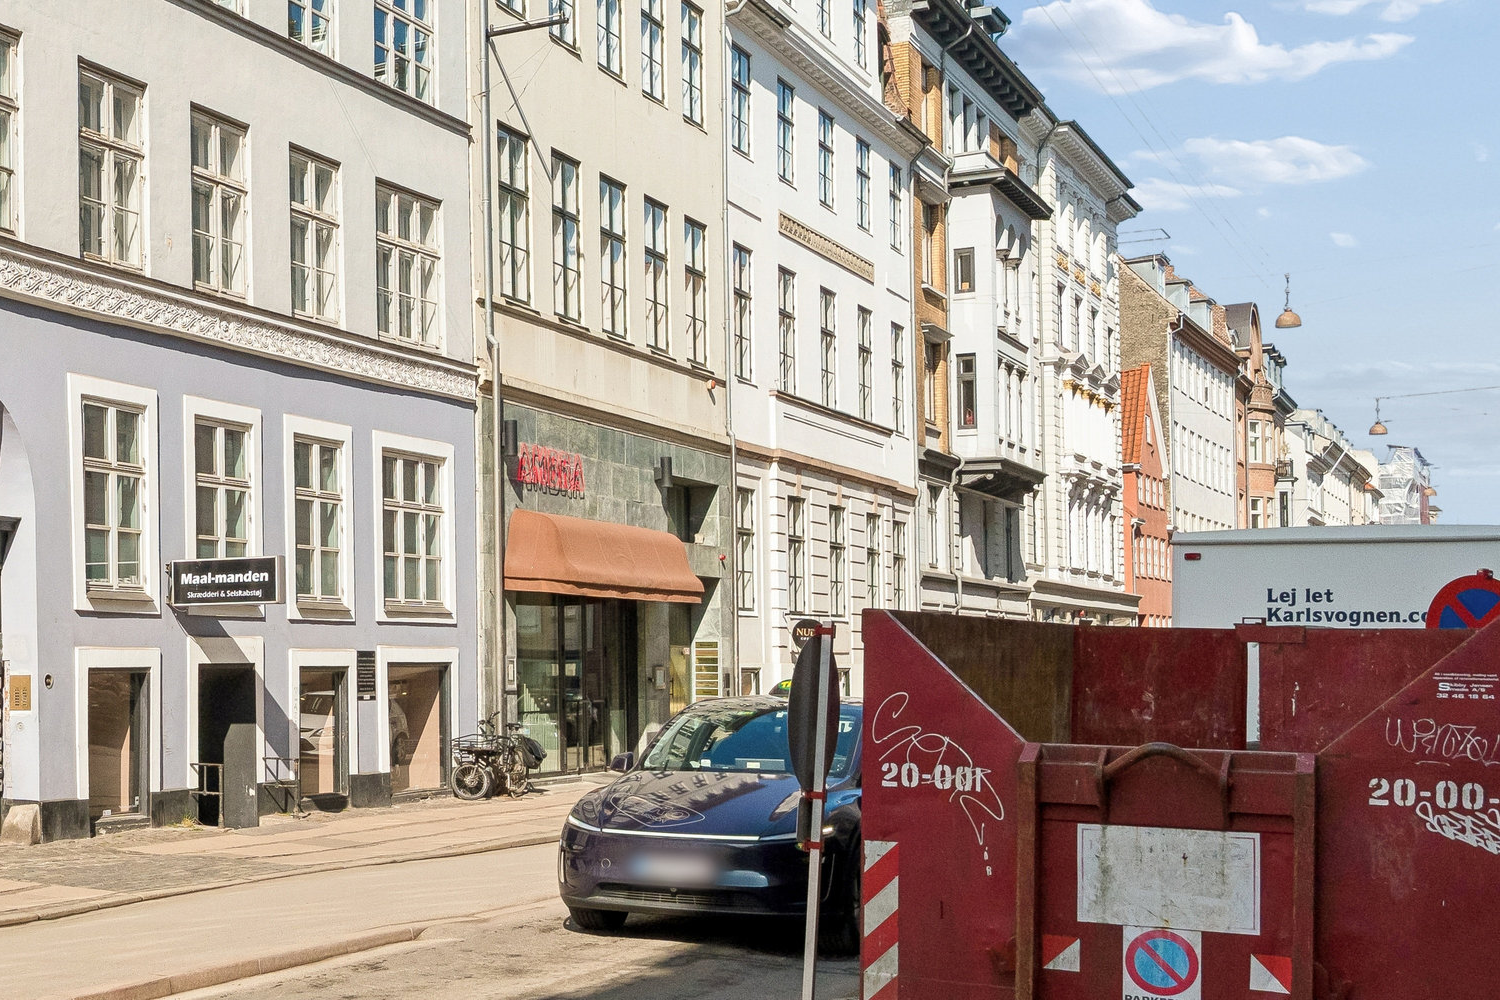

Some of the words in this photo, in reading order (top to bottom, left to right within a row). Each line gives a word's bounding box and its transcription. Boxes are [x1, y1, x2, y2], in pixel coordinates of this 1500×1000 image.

[180, 570, 269, 585] Maal-manden
[187, 591, 219, 599] Skrædderi
[226, 589, 262, 598] Selskabstøj
[1266, 588, 1297, 606] Lej
[1305, 588, 1334, 603] let
[796, 628, 816, 637] NUD
